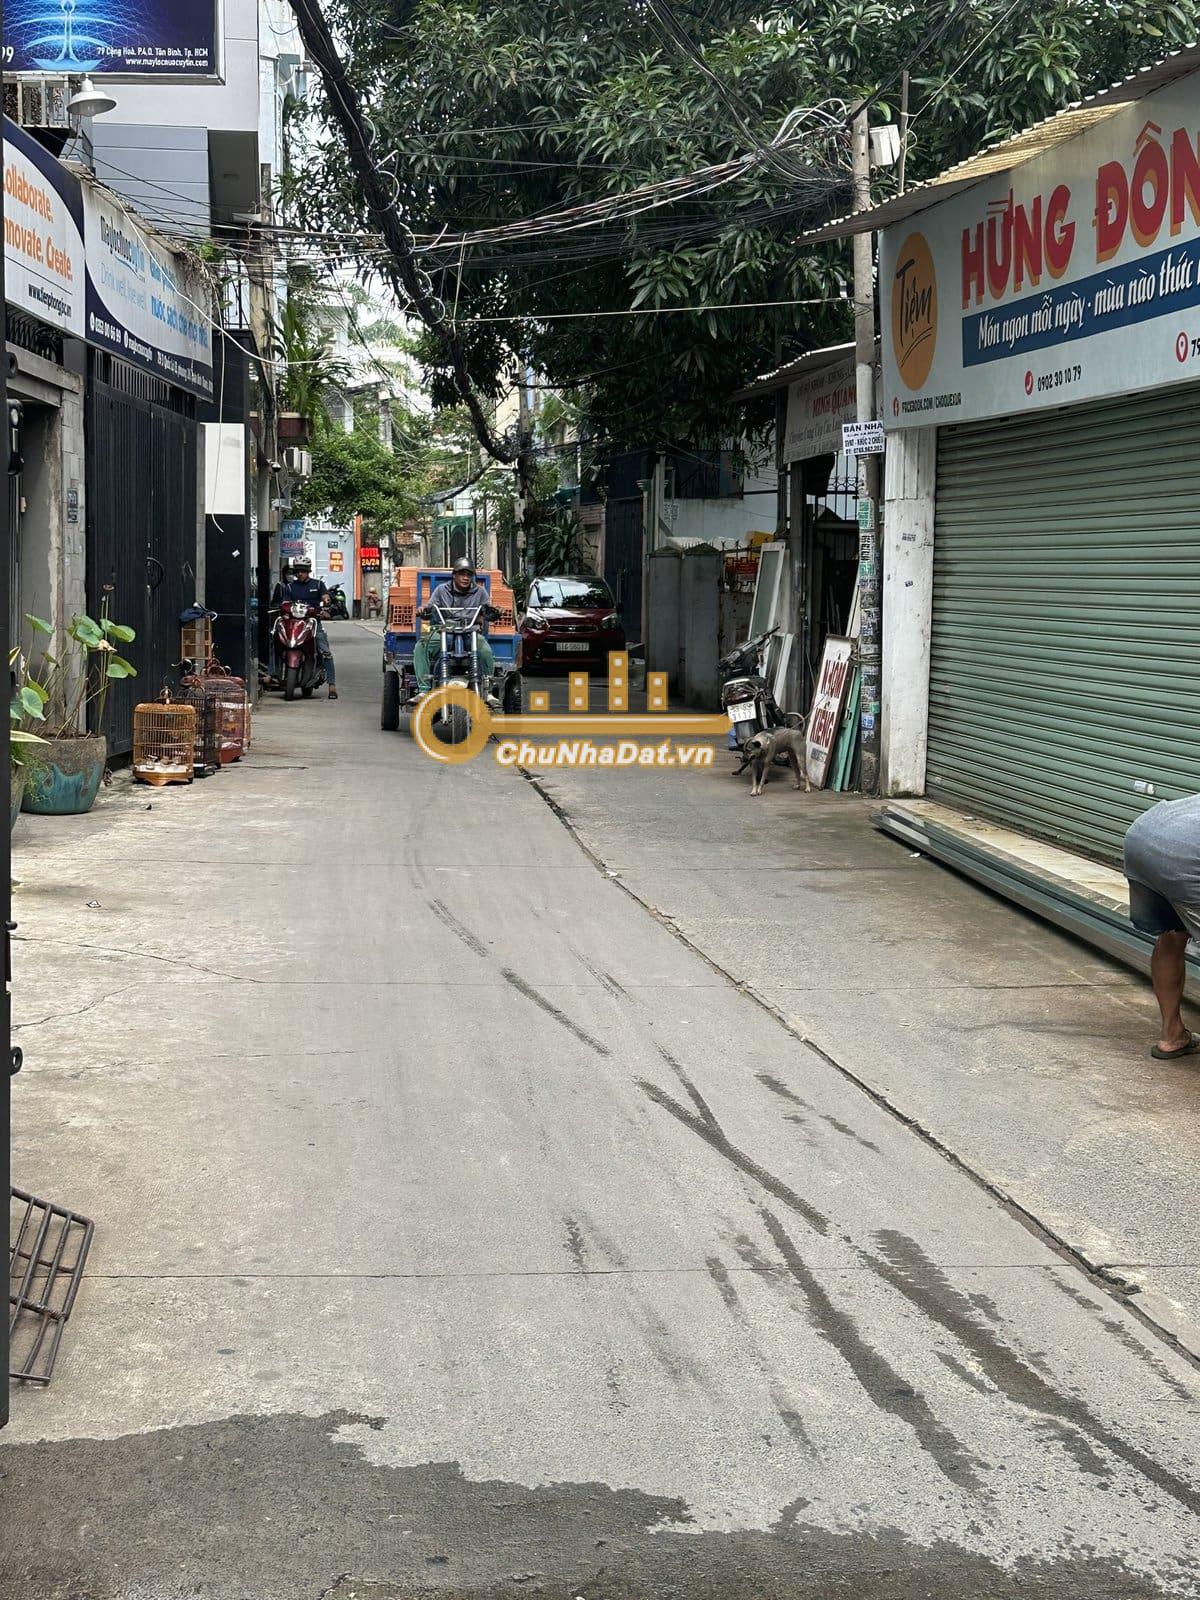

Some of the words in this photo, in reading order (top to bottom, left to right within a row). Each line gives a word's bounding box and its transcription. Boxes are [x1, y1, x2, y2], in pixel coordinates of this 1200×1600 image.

[194, 48, 208, 56] HCM
[4, 163, 54, 223] ollaborate.
[47, 236, 73, 281] Create.
[962, 185, 1076, 310] HỪNG
[896, 259, 932, 347] Tiệm
[978, 316, 1000, 350] Món
[1002, 313, 1029, 349] ngon
[1031, 294, 1053, 333] mỗi
[1055, 291, 1086, 334] ngày
[1094, 279, 1124, 317] mùa
[1127, 268, 1155, 307] nào
[1159, 250, 1194, 297] thức
[1037, 373, 1053, 392] 0902
[1055, 370, 1063, 387] 30
[1064, 367, 1072, 384] 10
[1073, 364, 1082, 382] 79
